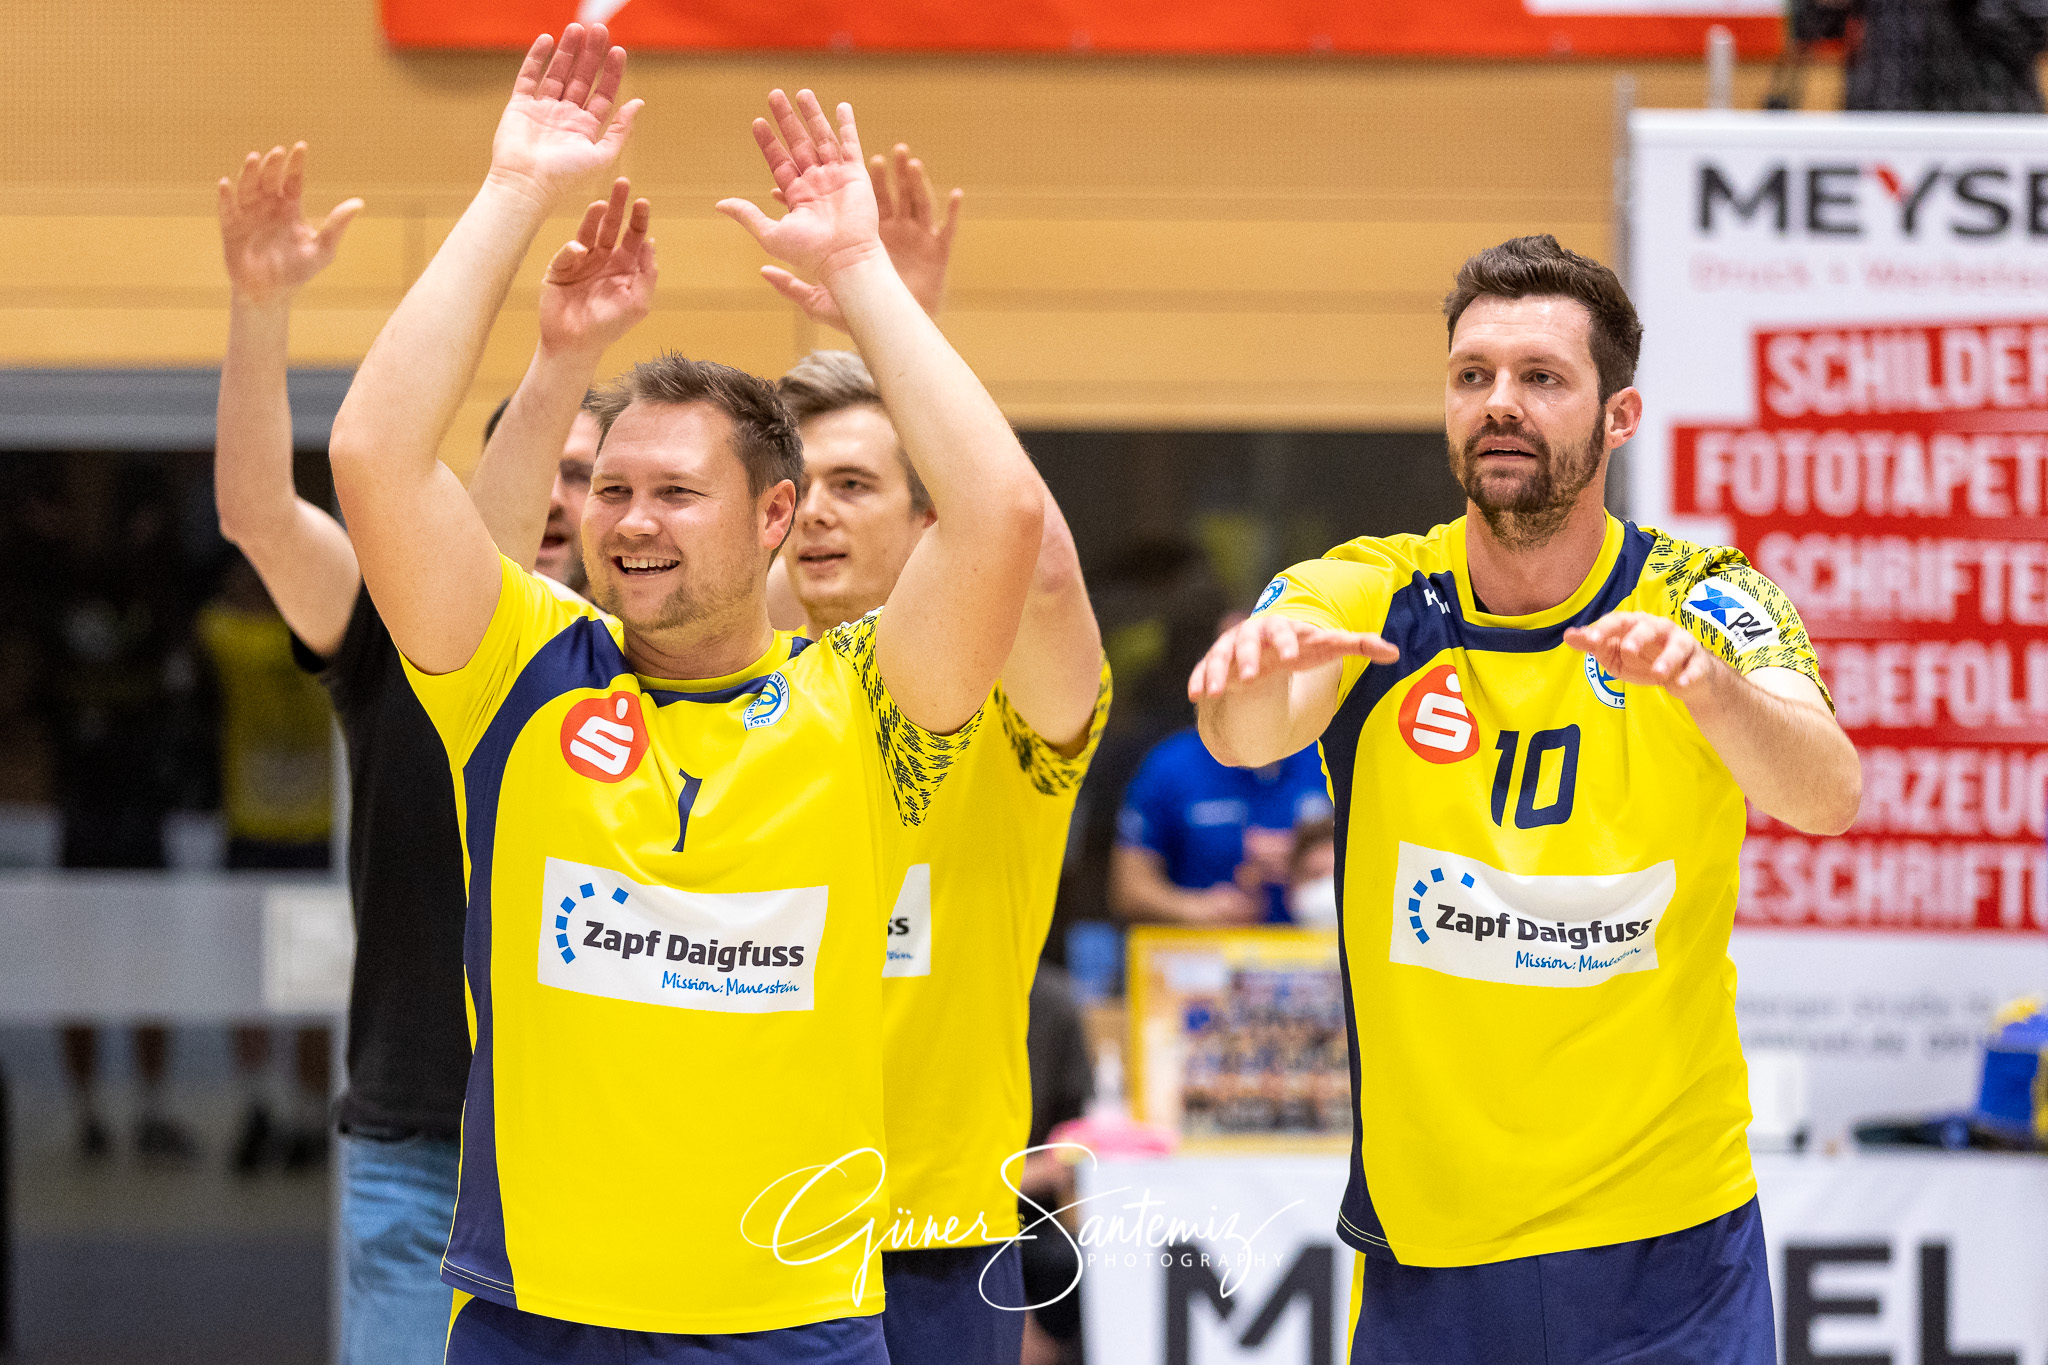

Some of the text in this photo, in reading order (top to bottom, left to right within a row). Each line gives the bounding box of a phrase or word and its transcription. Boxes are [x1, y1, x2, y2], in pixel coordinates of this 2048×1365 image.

[1693, 431, 2048, 520] FOTOTAPET
[1490, 723, 1582, 830] 10
[671, 768, 703, 853] 1
[582, 920, 805, 972] Zapf Daigfuss
[1435, 903, 1653, 950] Zapf Daigfuss
[661, 970, 724, 993] Mission:
[1515, 950, 1577, 970] Mission:
